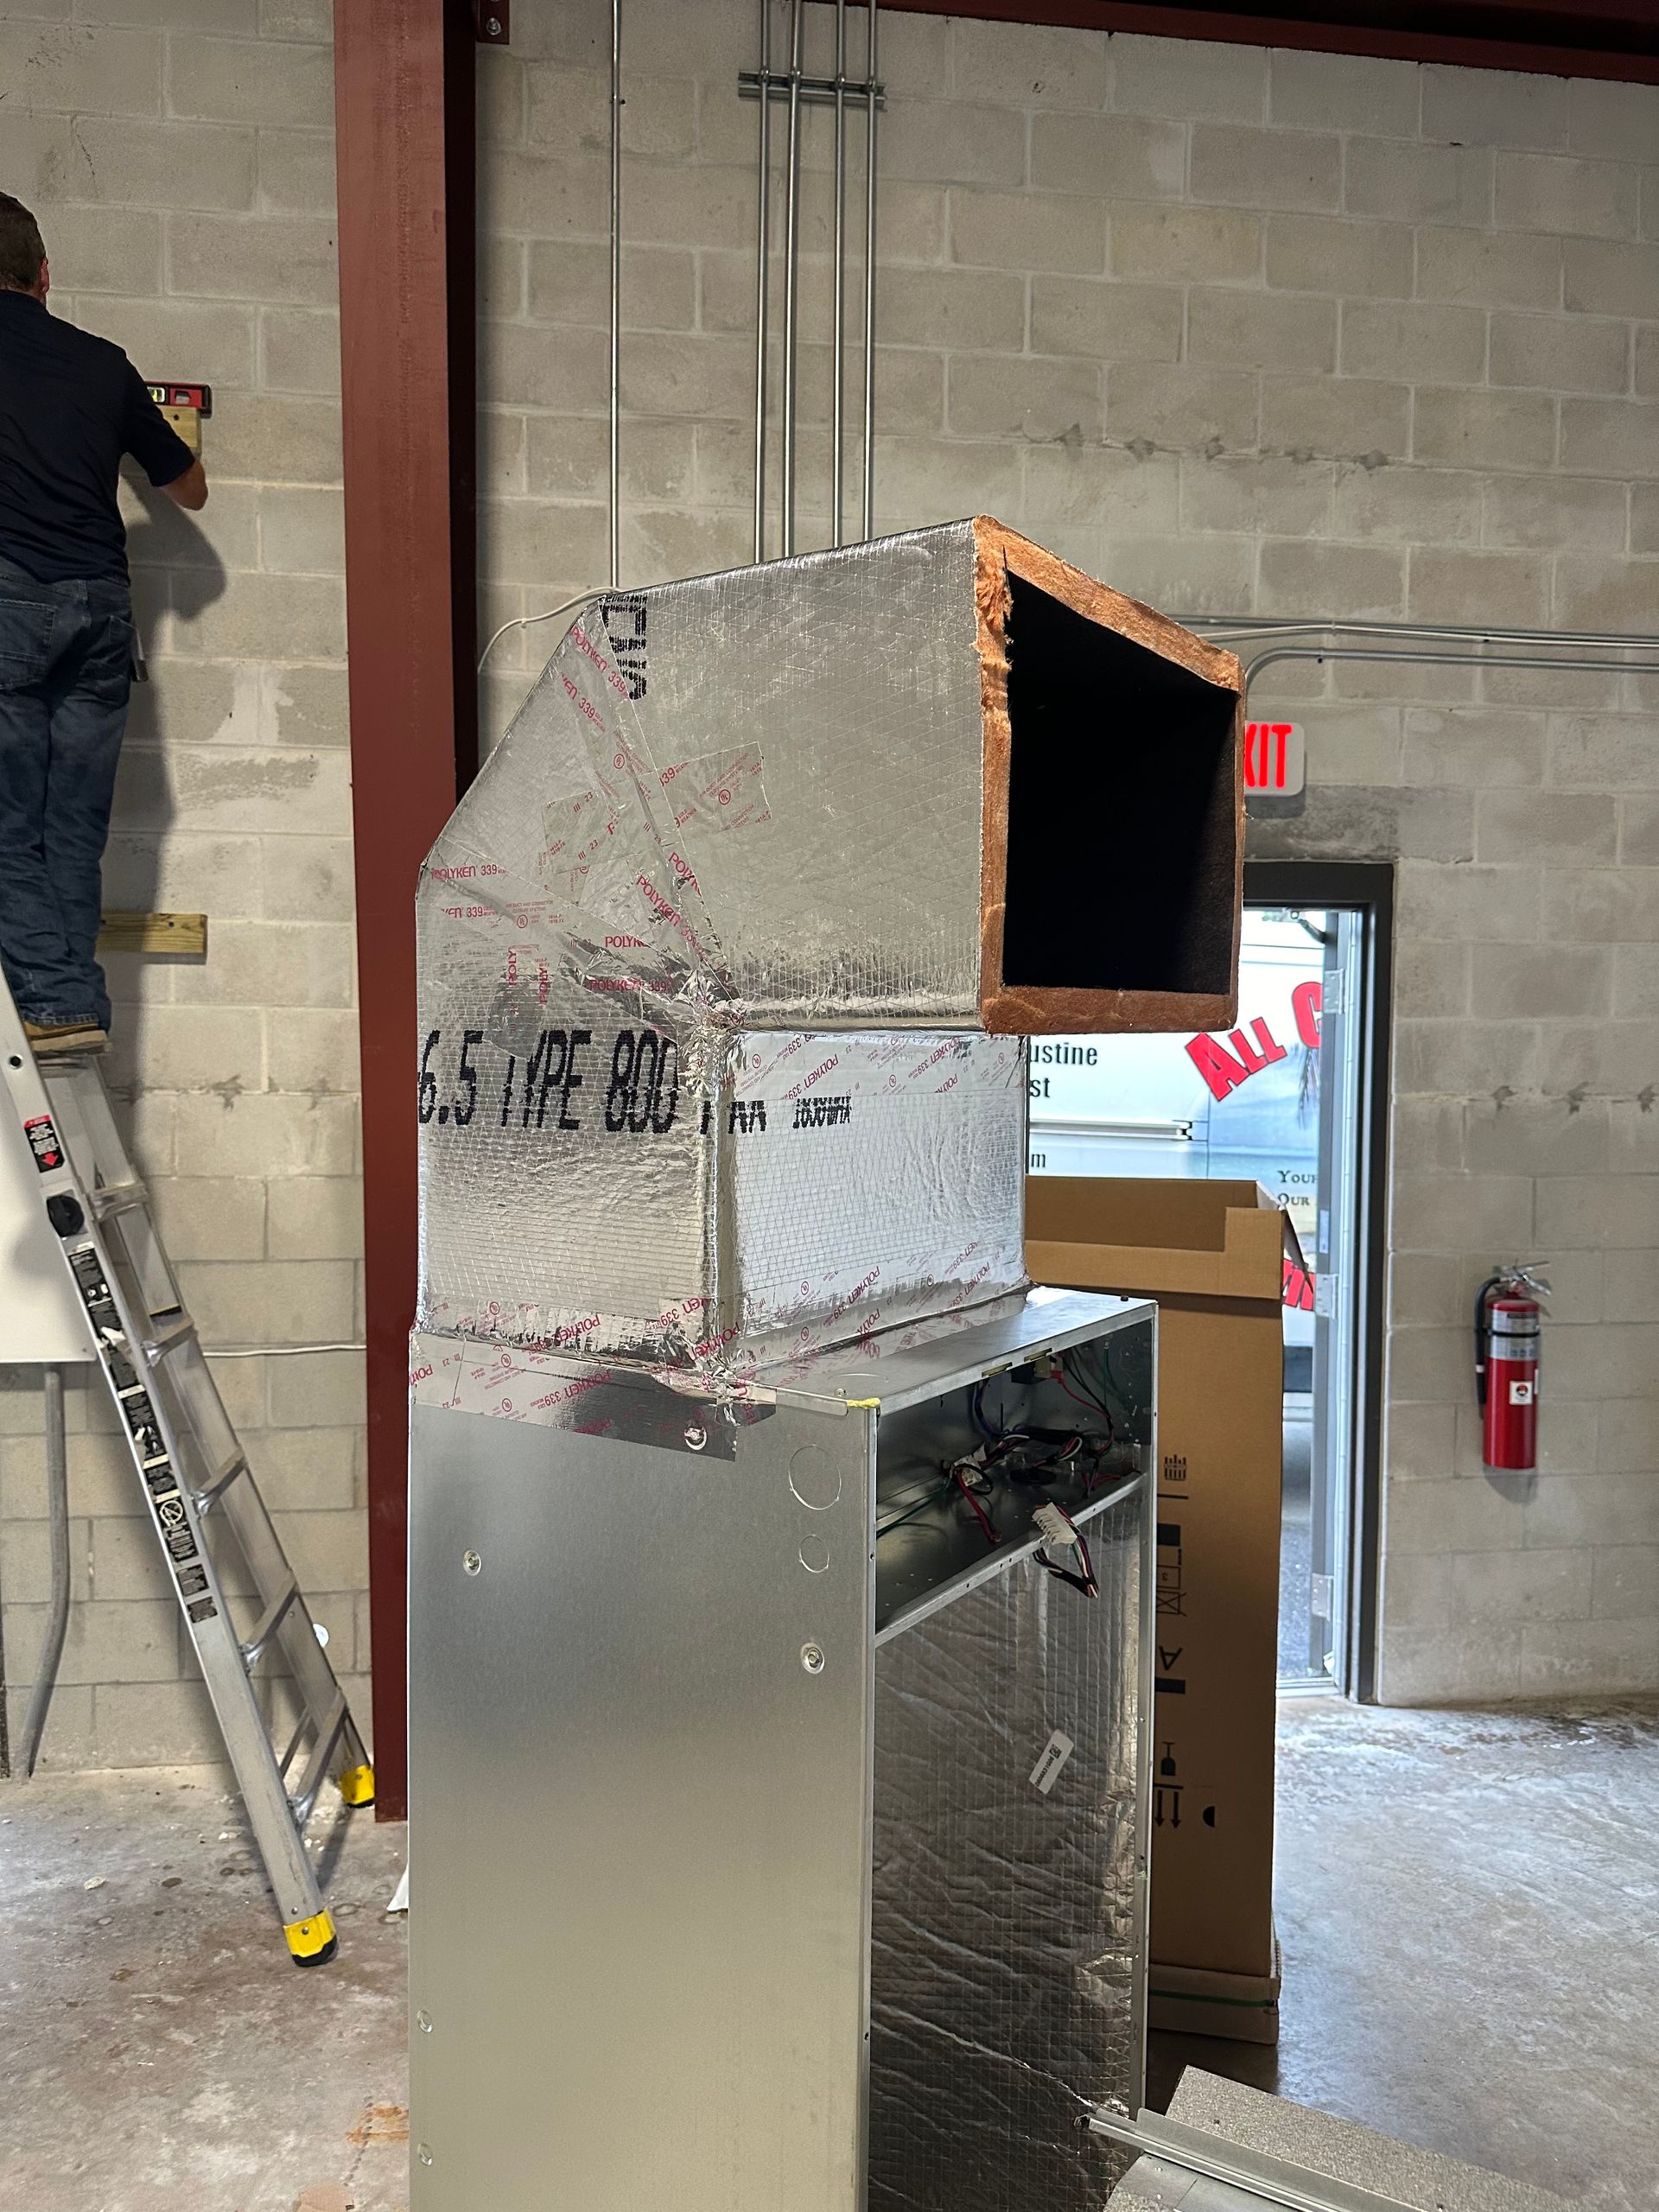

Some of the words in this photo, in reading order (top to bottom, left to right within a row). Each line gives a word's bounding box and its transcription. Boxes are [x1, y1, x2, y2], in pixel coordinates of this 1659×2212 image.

[579, 697, 595, 718] 339
[1244, 723, 1293, 788] XIT
[589, 839, 598, 850] 23
[481, 864, 498, 875] 339
[636, 875, 682, 927] POLYKEN
[467, 906, 483, 918] 339
[918, 1059, 929, 1074] 339
[1185, 1017, 1287, 1102] ALL
[418, 1029, 484, 1125] 6.5
[804, 1054, 839, 1089] POLYKEN
[849, 1266, 880, 1304] POLYKEN
[964, 1262, 990, 1295] POLYKEN
[660, 1309, 679, 1325] 339
[833, 1301, 847, 1319] 339
[544, 1391, 562, 1406] 339
